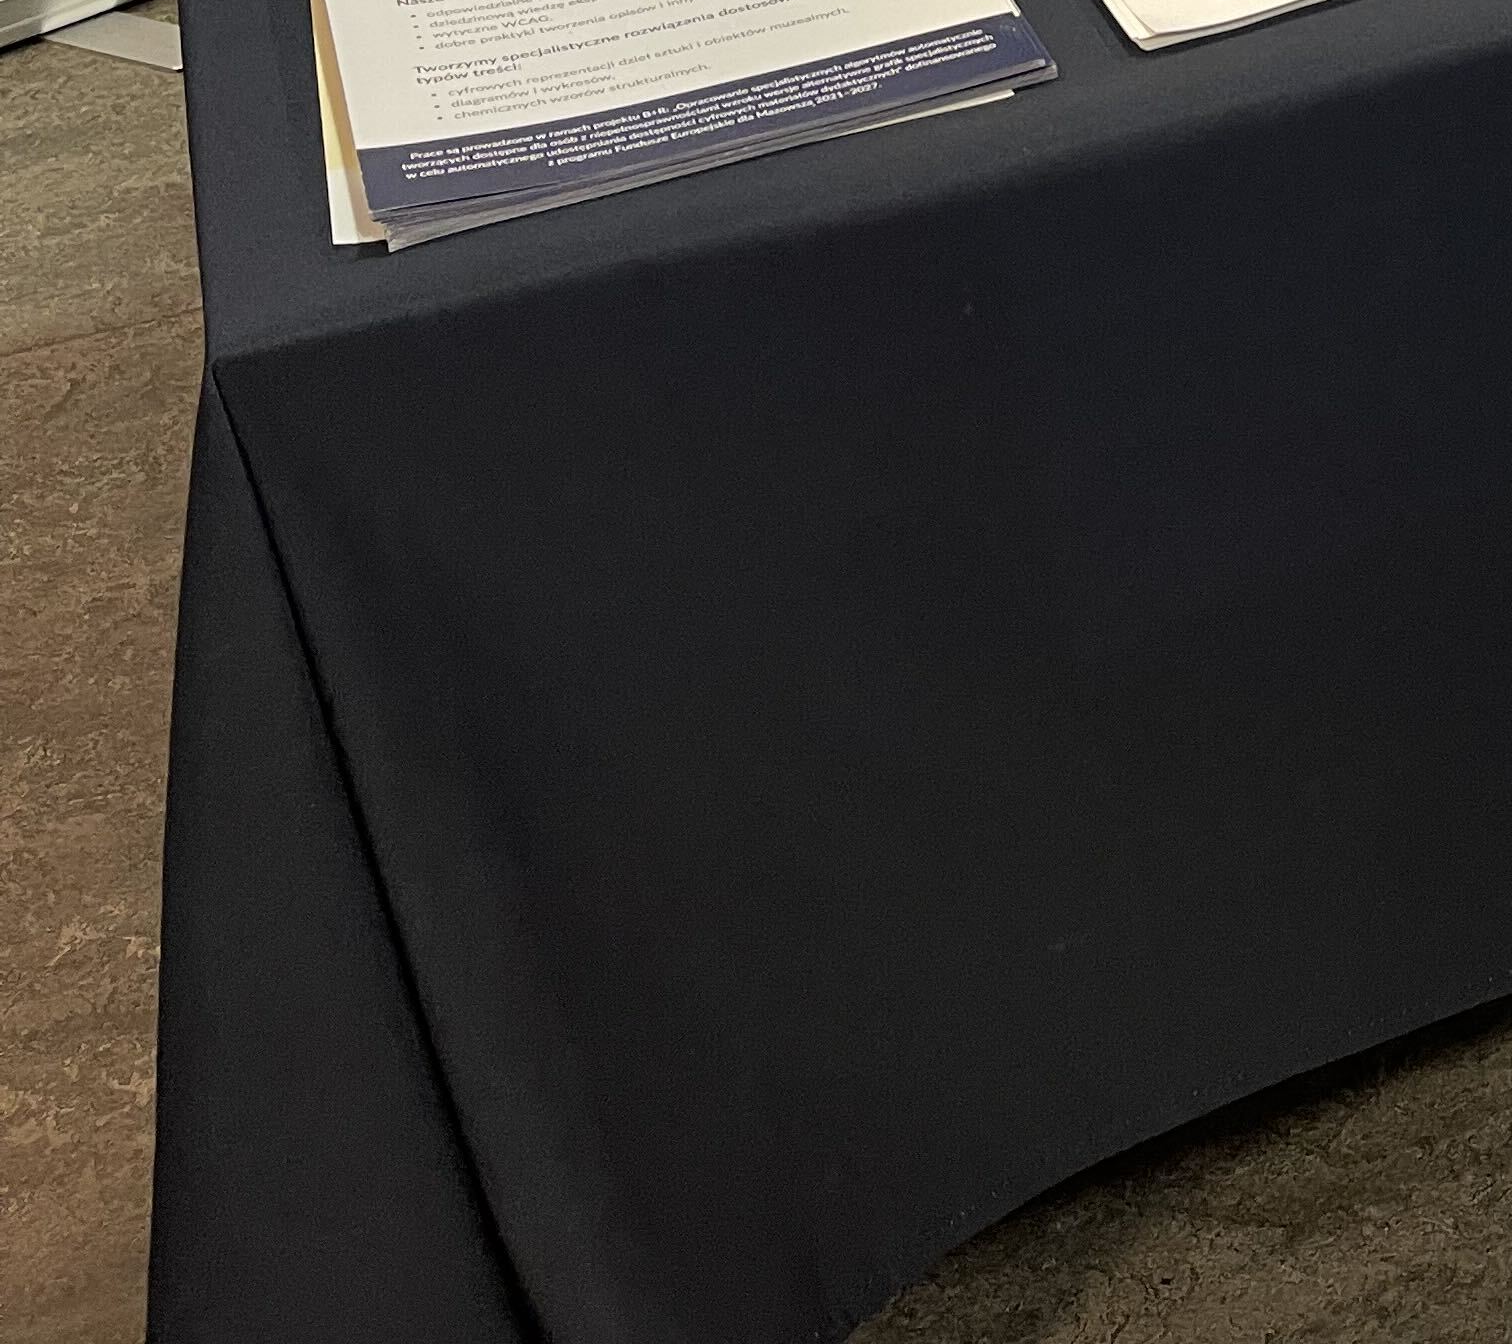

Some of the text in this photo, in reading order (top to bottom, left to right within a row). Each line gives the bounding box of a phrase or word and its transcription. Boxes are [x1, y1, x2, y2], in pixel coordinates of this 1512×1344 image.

[518, 2, 565, 16] wiedzę
[433, 24, 498, 39] wytyczne
[435, 38, 476, 50] dobre
[480, 28, 535, 45] praktyki
[540, 14, 606, 35] tworzenia
[609, 5, 656, 20] opisów
[415, 57, 497, 74] Tworzymy
[501, 33, 620, 63] specjalistyczne
[624, 13, 715, 39] rozwiązania
[416, 71, 468, 85] typów
[526, 62, 615, 83] reprezentacji
[454, 97, 547, 120] chemicznych
[550, 88, 605, 105] wzorów
